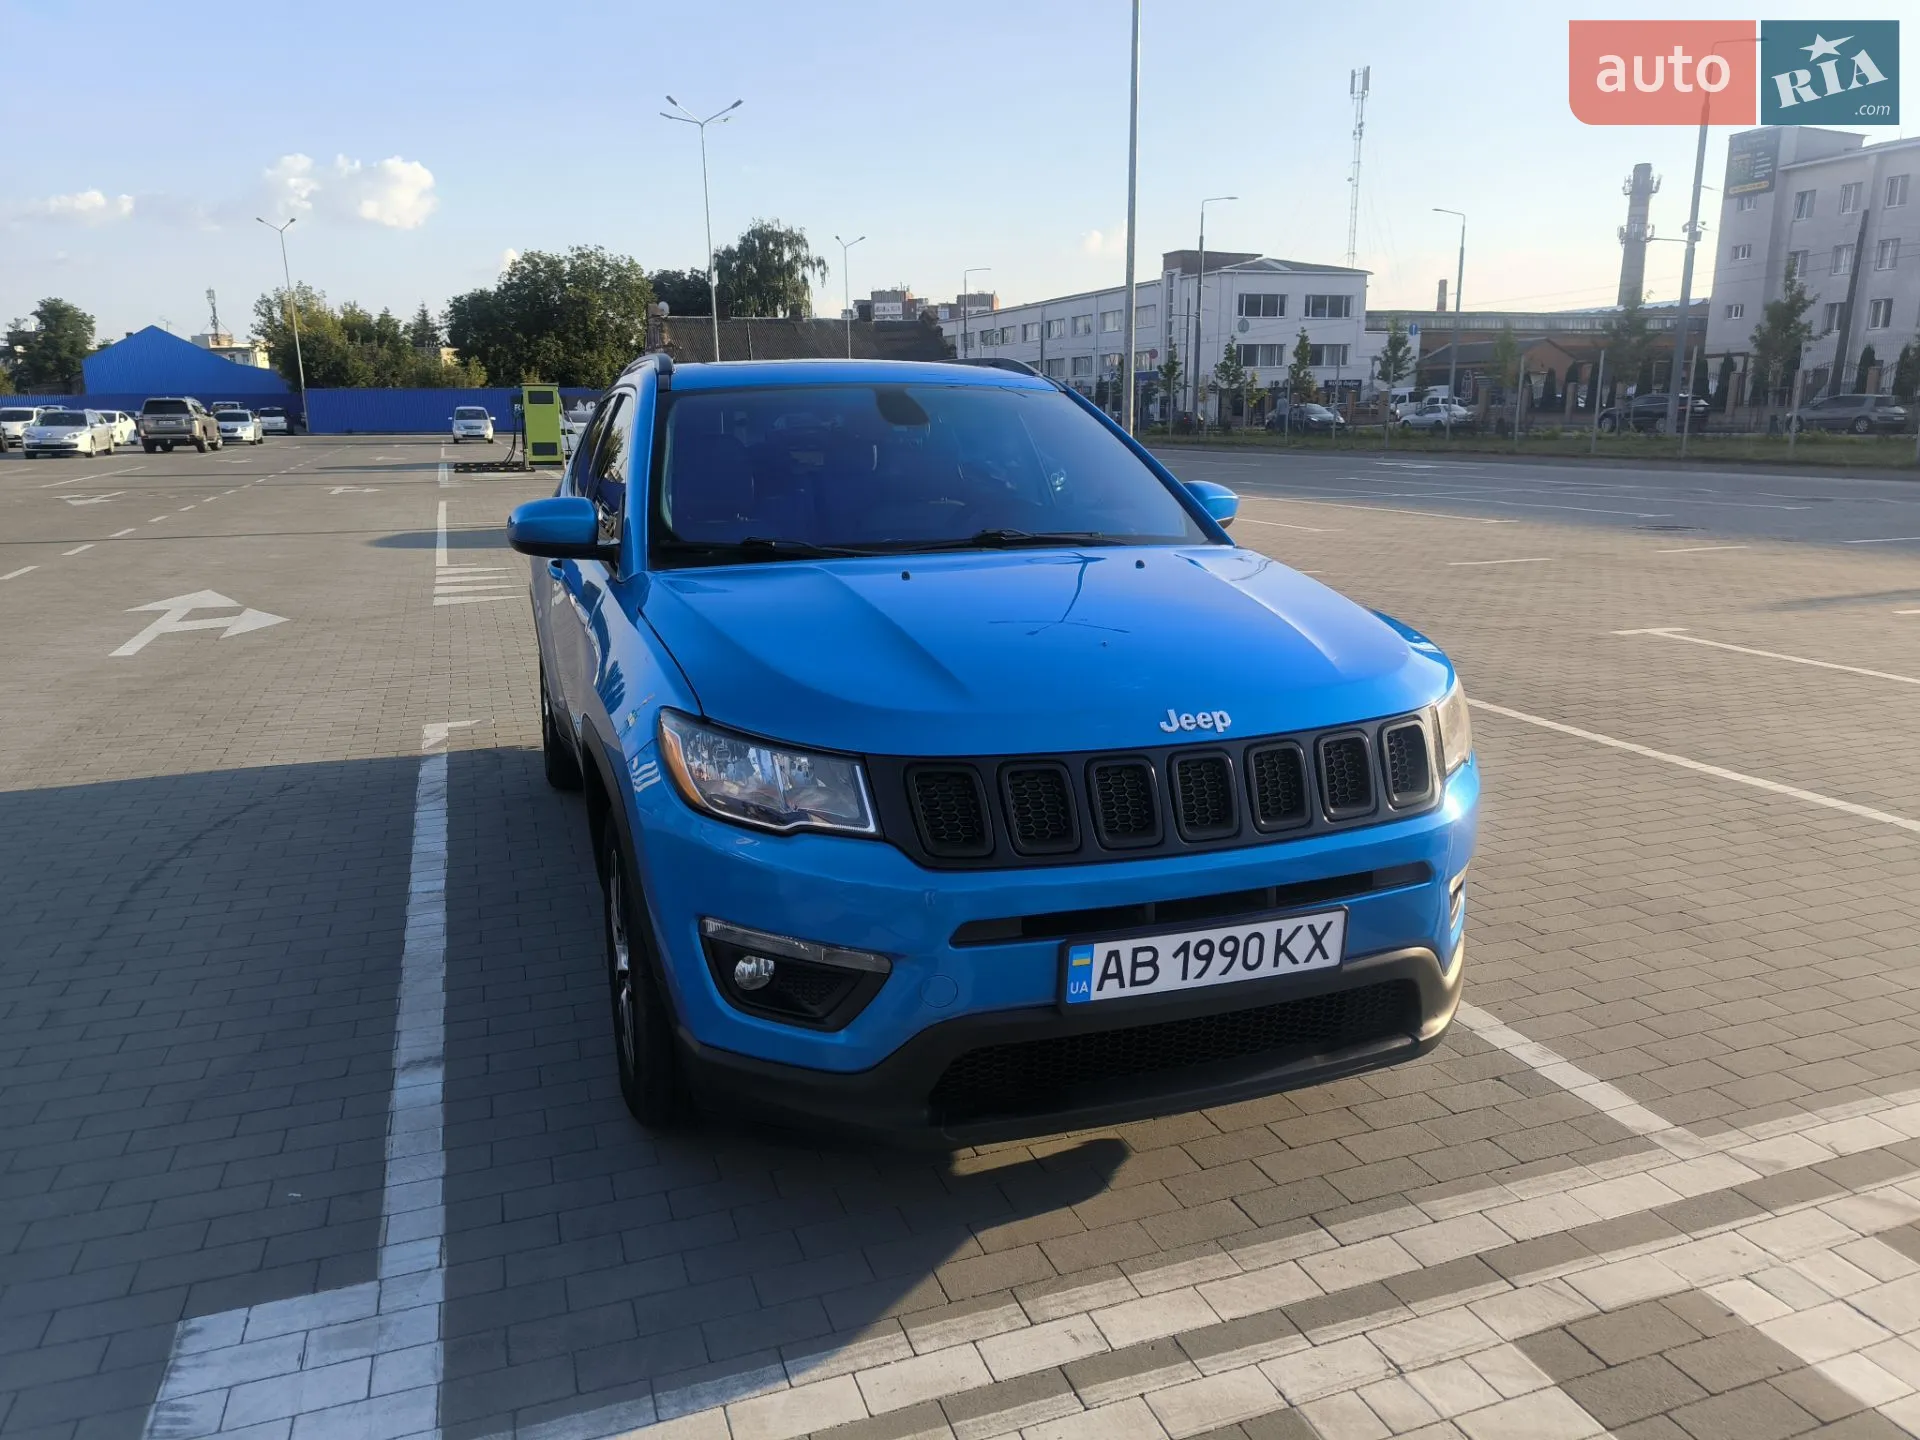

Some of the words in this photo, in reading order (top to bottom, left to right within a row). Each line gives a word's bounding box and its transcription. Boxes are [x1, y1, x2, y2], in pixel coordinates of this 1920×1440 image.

[1159, 708, 1231, 733] Jeep
[1096, 946, 1160, 992] AB
[1172, 931, 1265, 981] 1990
[1272, 921, 1333, 968] KX
[1070, 981, 1089, 994] UA
